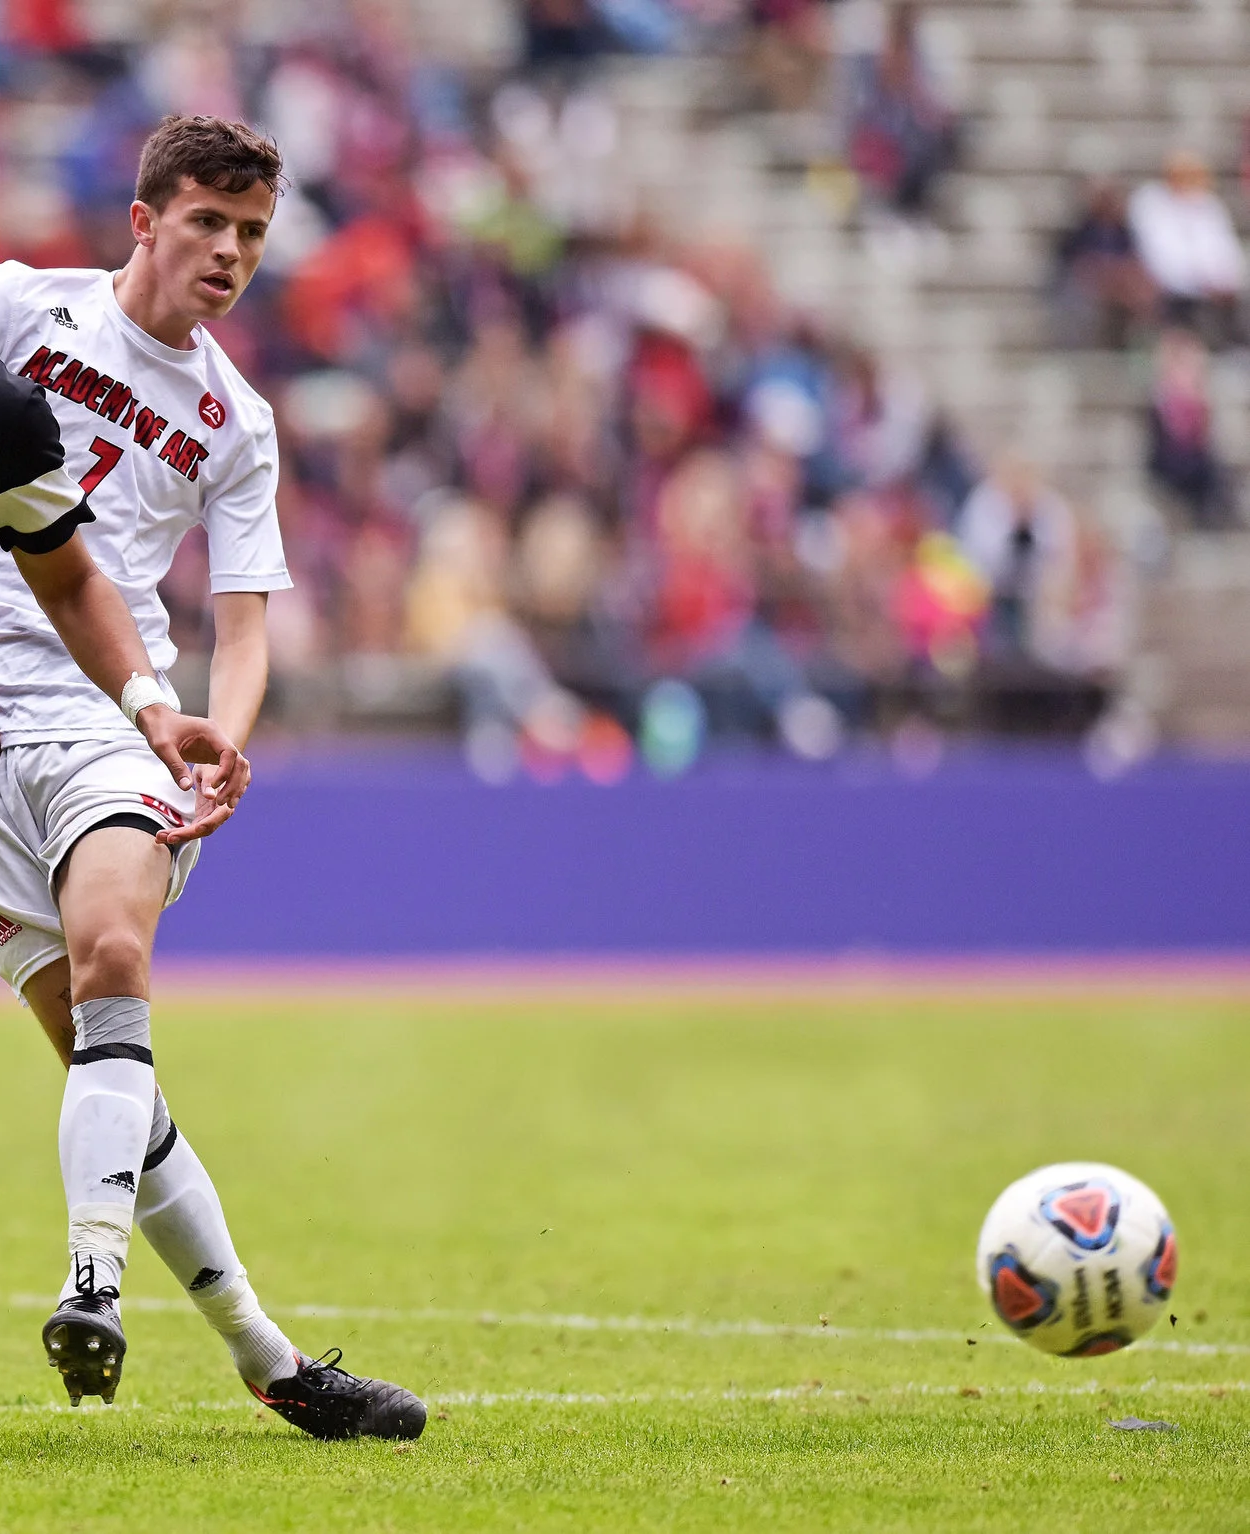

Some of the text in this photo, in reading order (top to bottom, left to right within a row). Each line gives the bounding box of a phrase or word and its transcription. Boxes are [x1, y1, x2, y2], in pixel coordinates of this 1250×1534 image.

[18, 345, 210, 482] ACADEMY OF ART
[78, 436, 125, 495] 7
